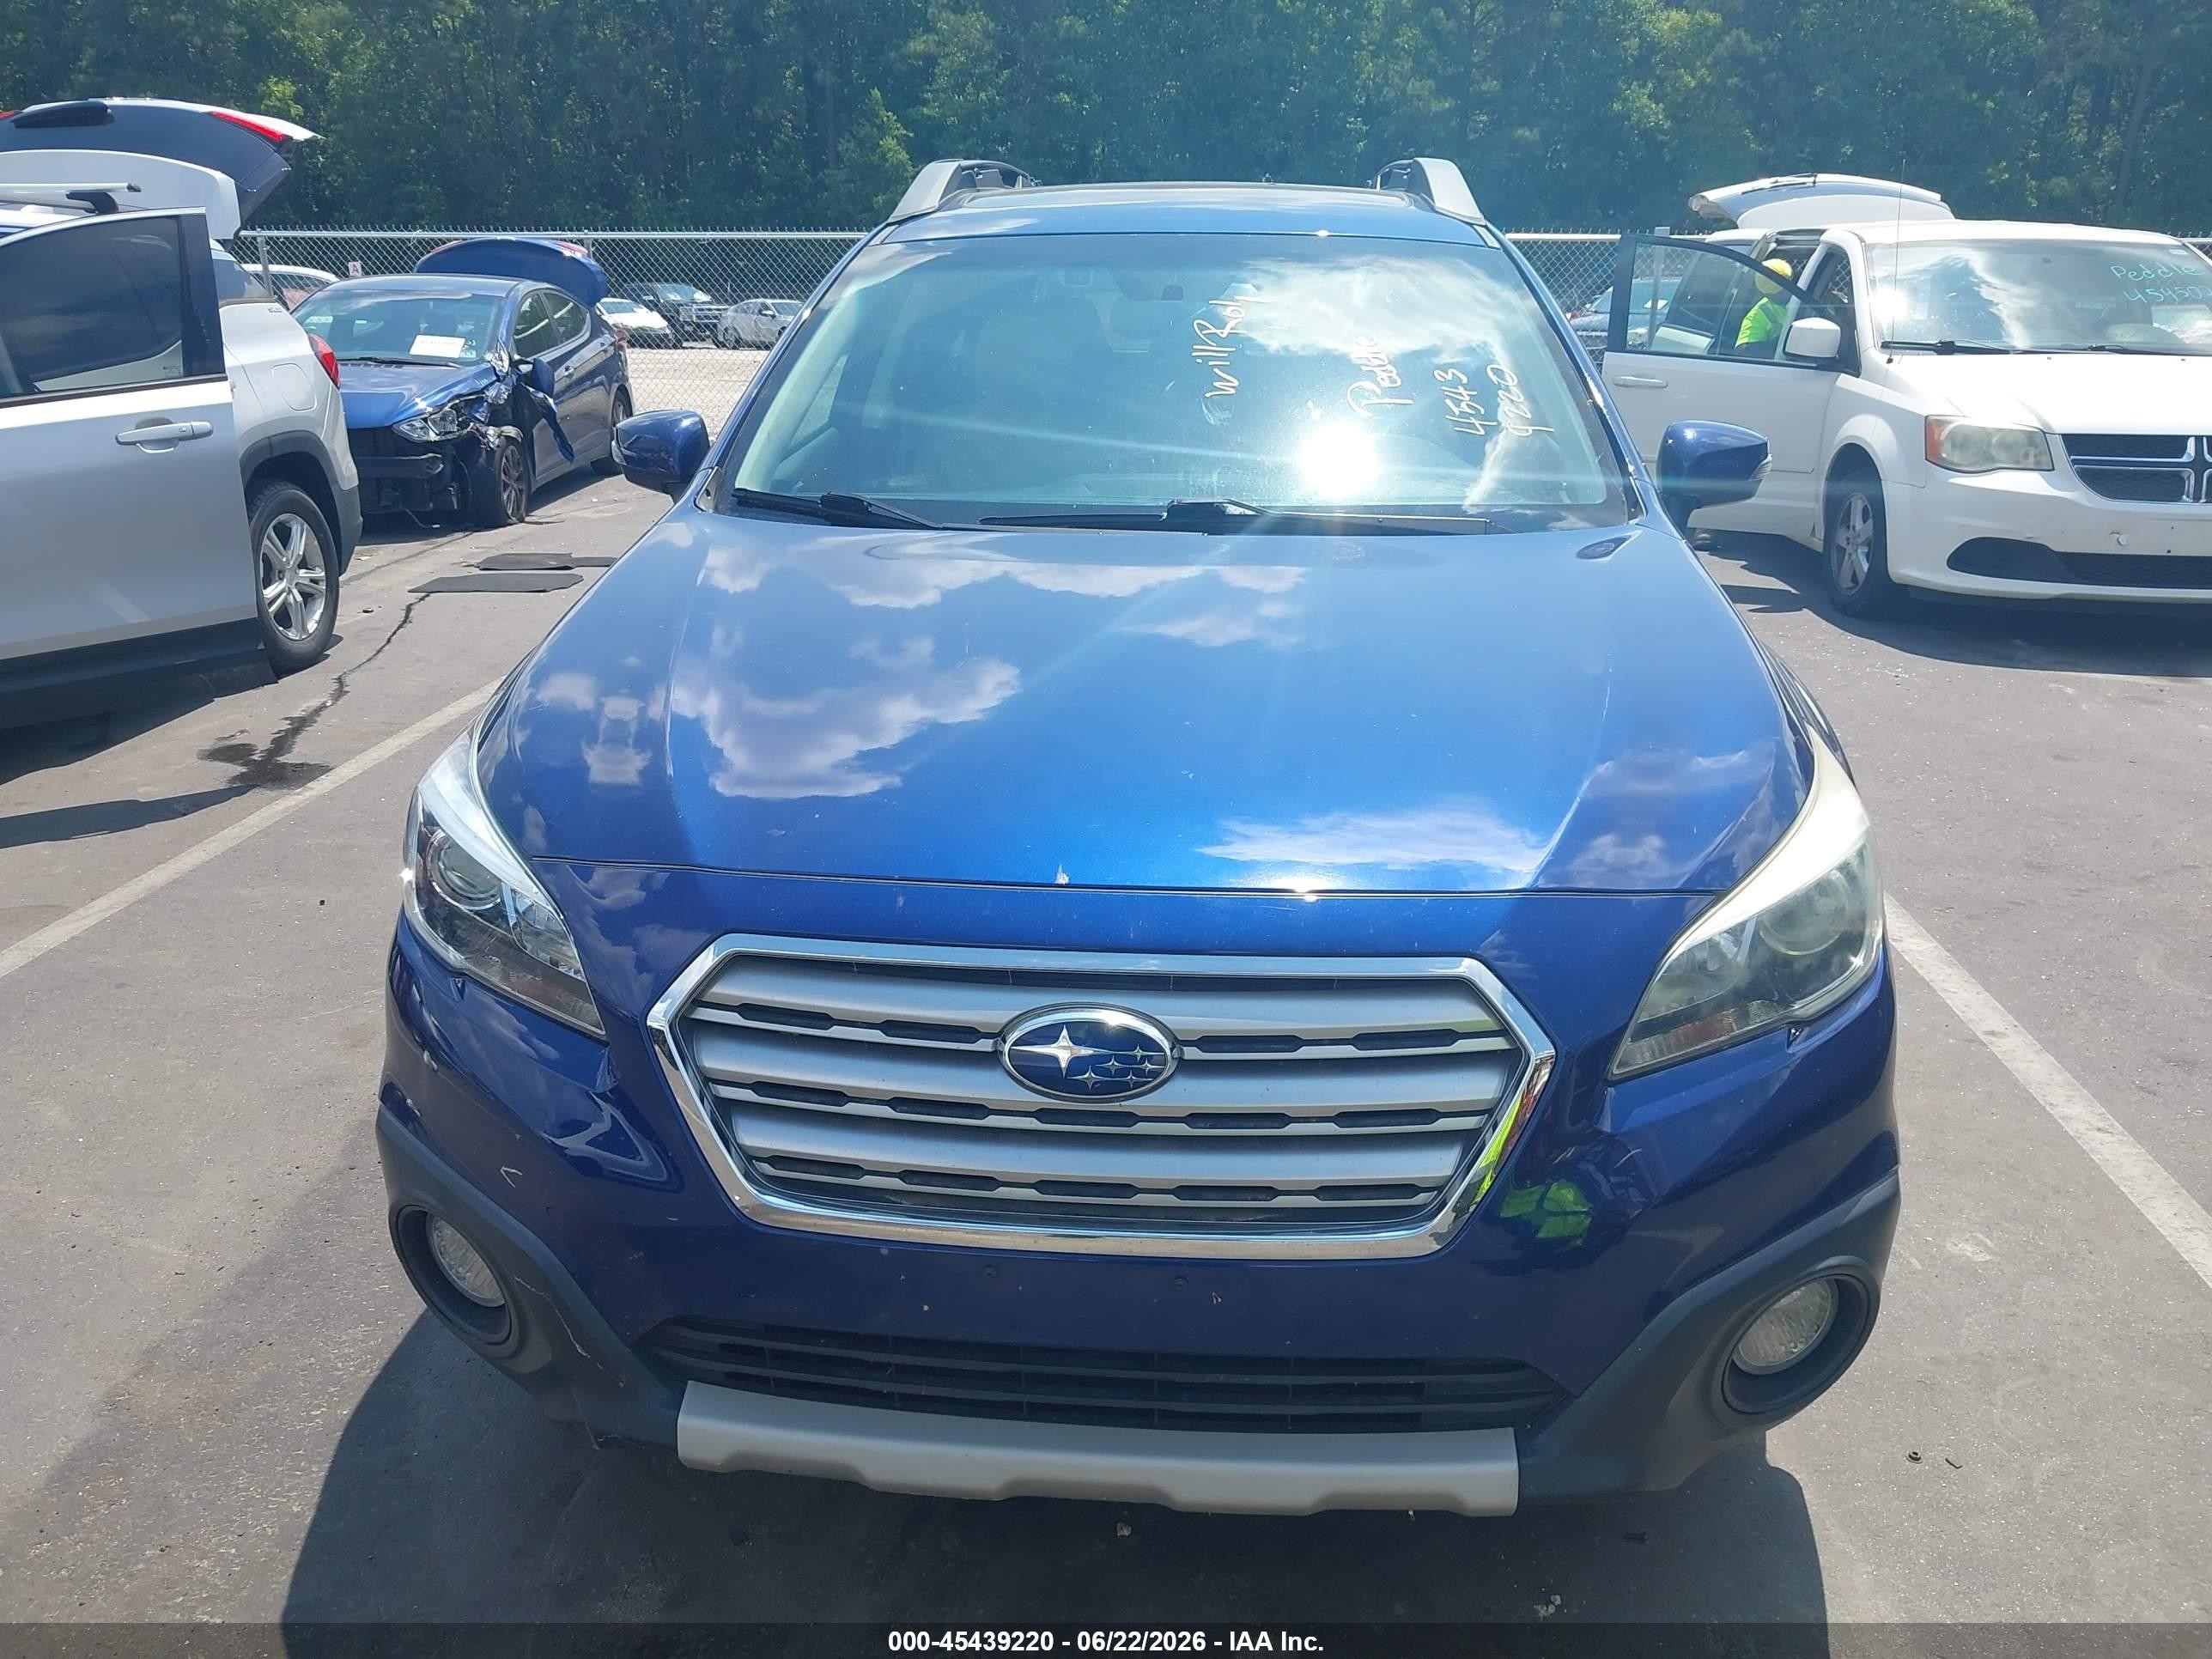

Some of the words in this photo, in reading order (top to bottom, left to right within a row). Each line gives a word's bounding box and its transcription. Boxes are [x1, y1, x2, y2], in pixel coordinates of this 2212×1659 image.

[2110, 261, 2206, 281] Peddle
[1435, 367, 1498, 436] 4543
[1485, 364, 1555, 437] 9220
